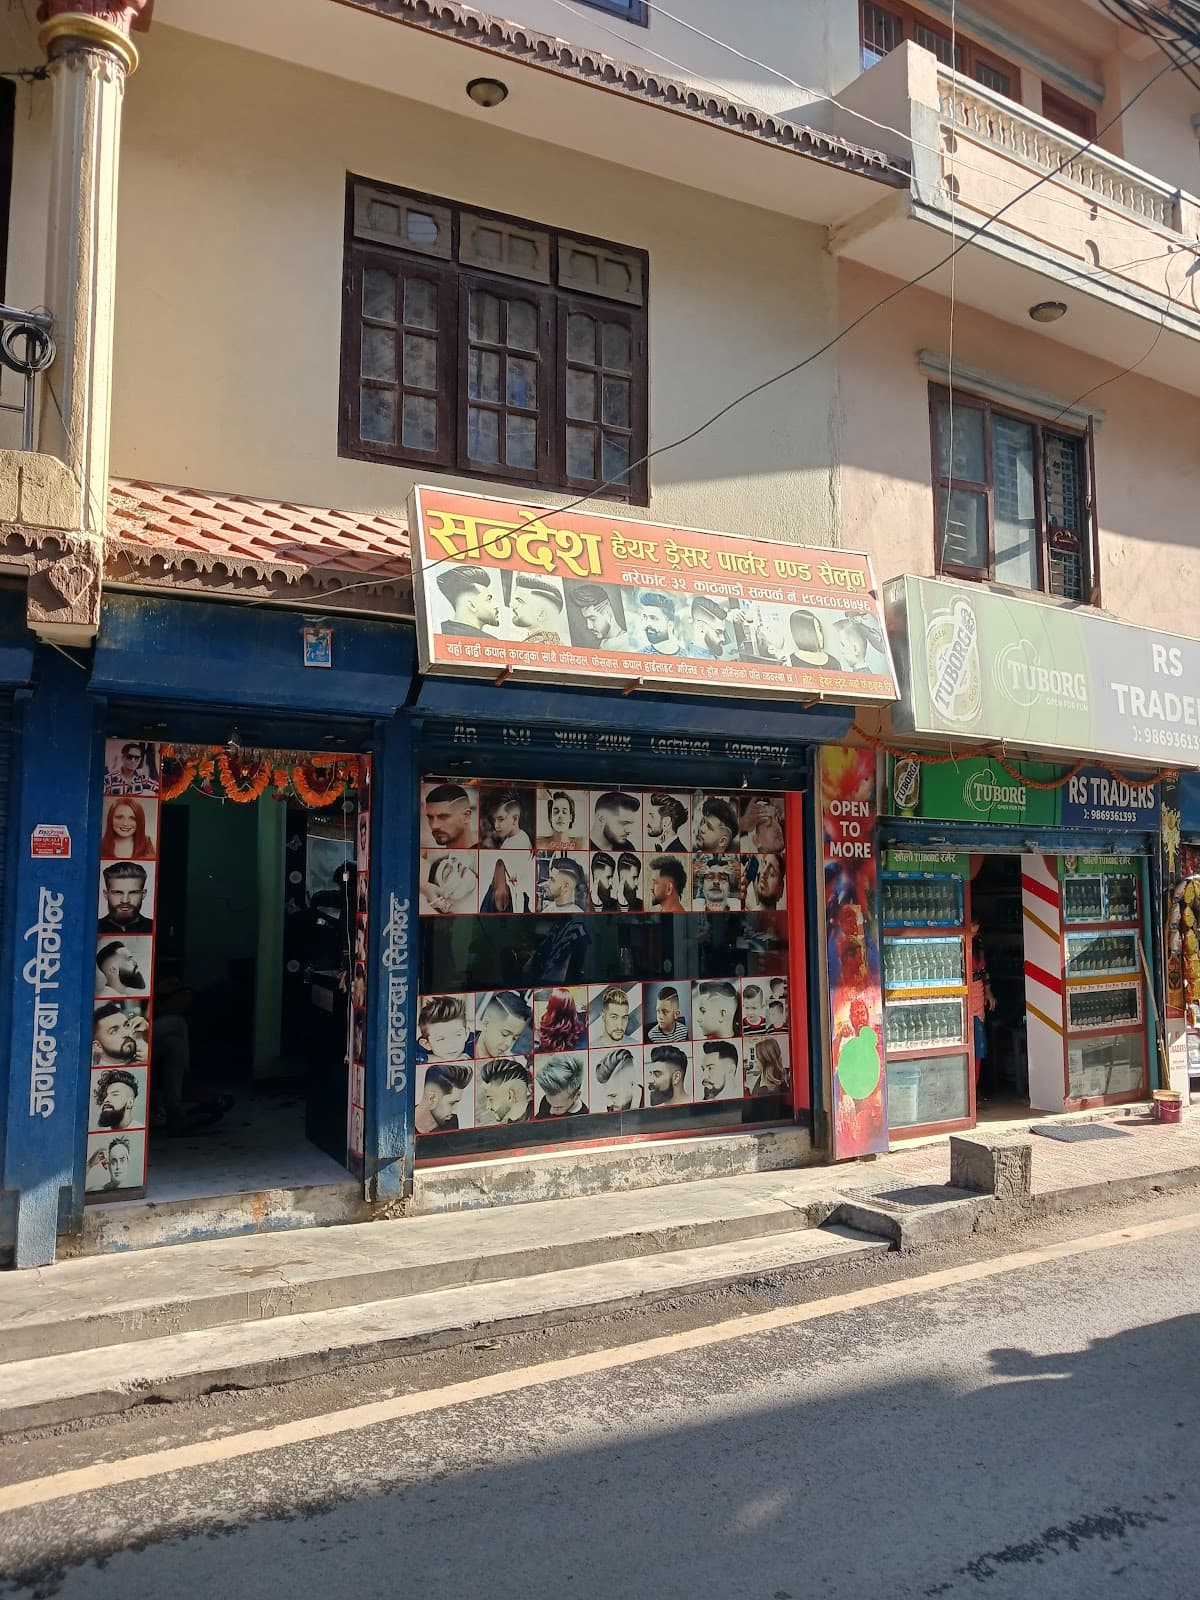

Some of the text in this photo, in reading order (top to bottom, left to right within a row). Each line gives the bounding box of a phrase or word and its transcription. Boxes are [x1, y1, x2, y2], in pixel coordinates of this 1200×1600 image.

[425, 510, 602, 577] सन्देश
[611, 530, 659, 563] हेयर
[664, 538, 712, 571] ड्रेसर
[773, 559, 812, 581] एण्ड
[816, 559, 866, 593] सैलून
[748, 585, 784, 601] सम्पर्क
[484, 646, 507, 659] कपाल
[935, 625, 973, 710] TUBORG
[1152, 643, 1183, 677] RS
[1007, 659, 1087, 702] TUBORG
[896, 763, 918, 801] TUBORG
[974, 783, 1026, 805] TUBORG
[1069, 775, 1088, 805] RS
[1090, 777, 1155, 809] TRADERS
[830, 800, 869, 817] OPEN
[840, 821, 861, 838] TO
[830, 841, 871, 858] MORE
[23, 886, 65, 996] सिमेन्ट
[382, 892, 410, 1093] जगदम्बा सिमेन्ट
[30, 995, 60, 1118] जगदम्बा
